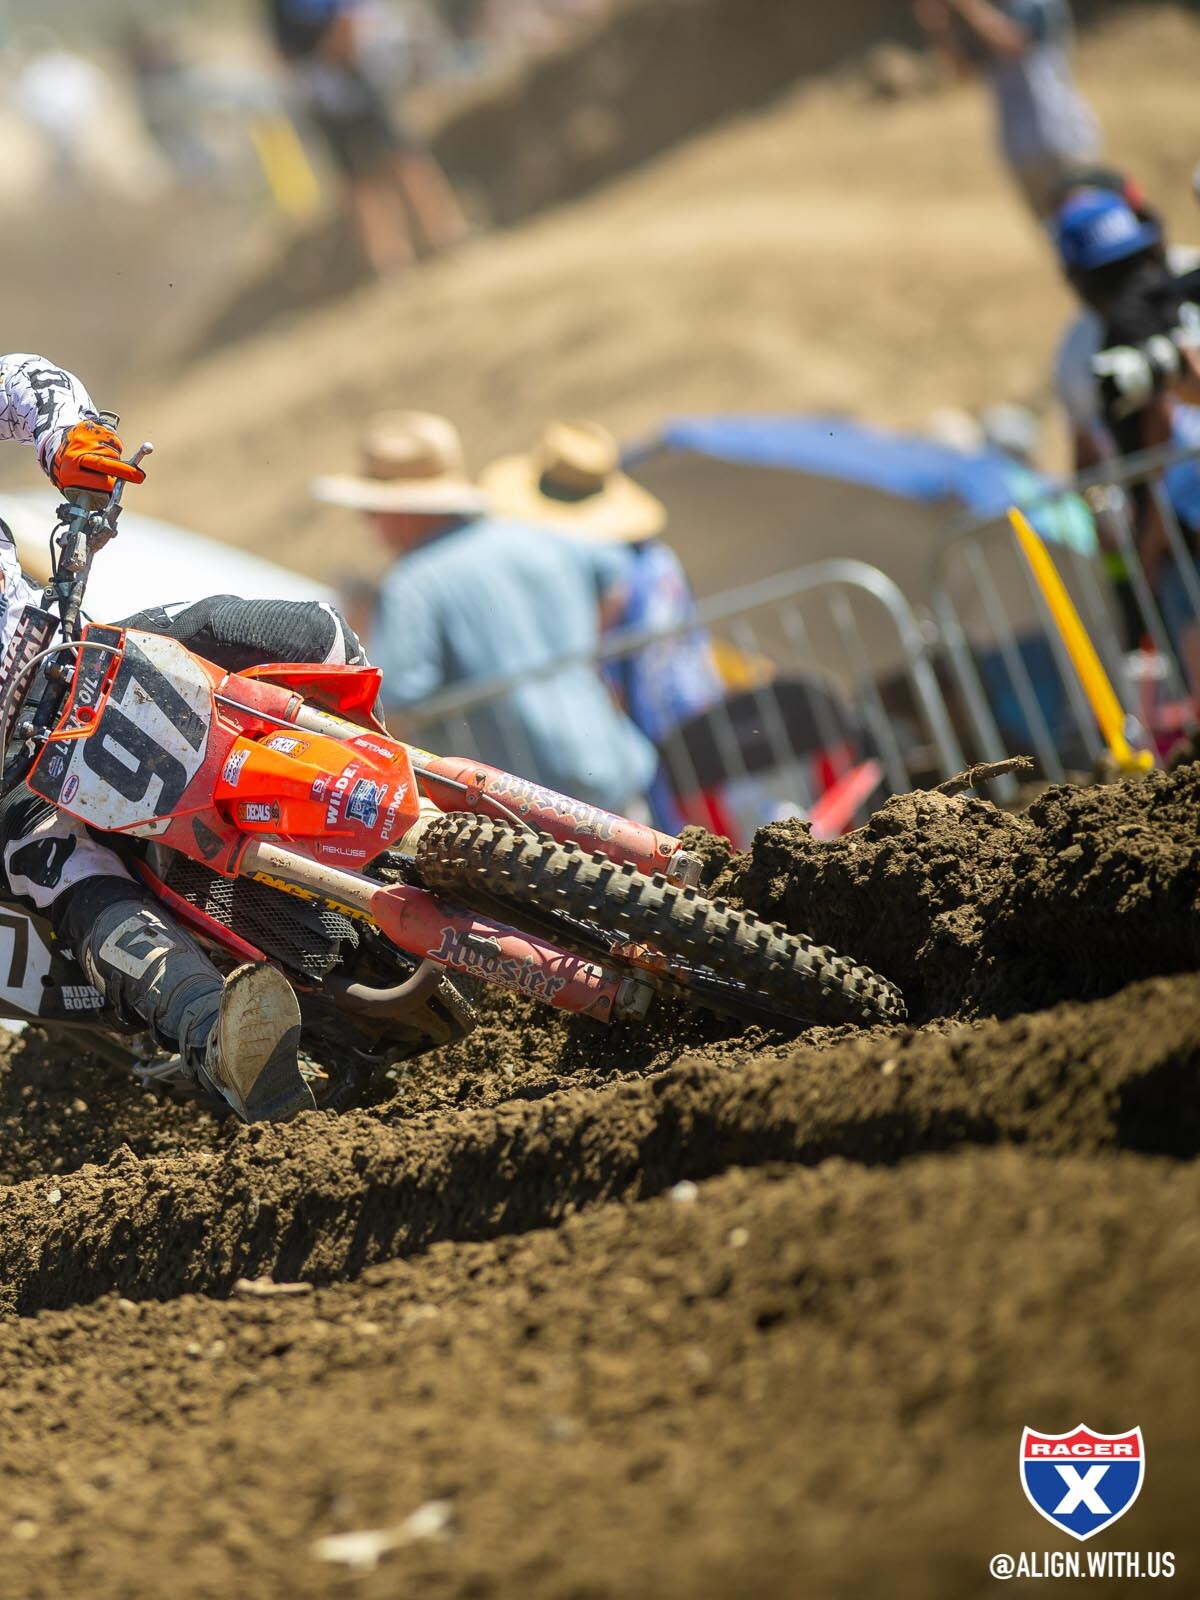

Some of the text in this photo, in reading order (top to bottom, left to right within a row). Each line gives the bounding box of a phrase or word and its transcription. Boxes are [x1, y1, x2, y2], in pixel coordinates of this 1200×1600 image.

[78, 677, 99, 704] OIL
[83, 637, 208, 818] 97
[322, 845, 367, 858] REKLUSE
[427, 926, 566, 998] Hoosier
